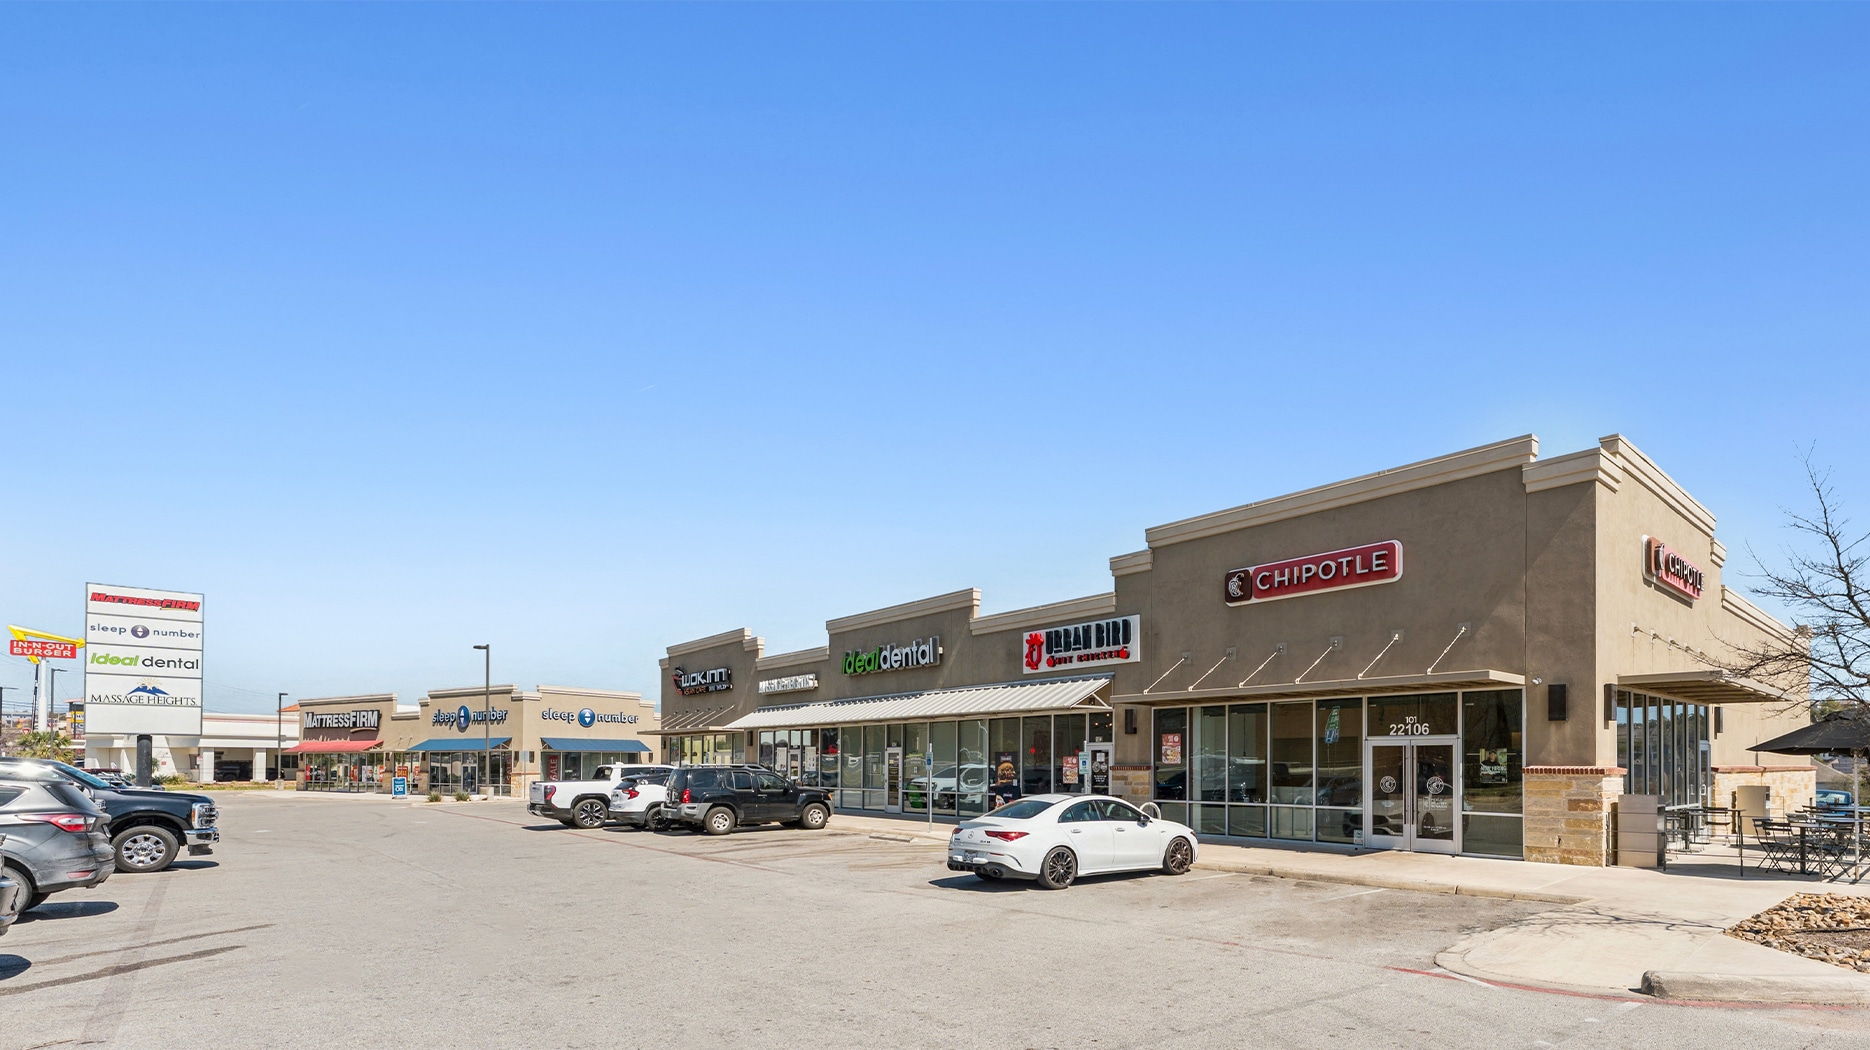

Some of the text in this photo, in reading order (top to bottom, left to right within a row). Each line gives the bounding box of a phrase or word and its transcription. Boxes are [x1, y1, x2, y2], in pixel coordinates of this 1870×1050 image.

[1256, 551, 1389, 591] CHIPOTLE
[1669, 552, 1705, 592] CHIPOTLE
[90, 623, 201, 639] sleep number
[1045, 619, 1132, 655] URBAN BIRD
[13, 641, 74, 650] IN-N-OUT
[13, 648, 72, 657] BURGER
[90, 652, 199, 670] ideal dental
[842, 637, 934, 674] ideal dental
[91, 694, 144, 704] MASSAGE
[432, 709, 456, 727] sleep
[542, 708, 639, 724] sleep number
[1405, 716, 1417, 724] 101
[1389, 723, 1430, 736] 22106
